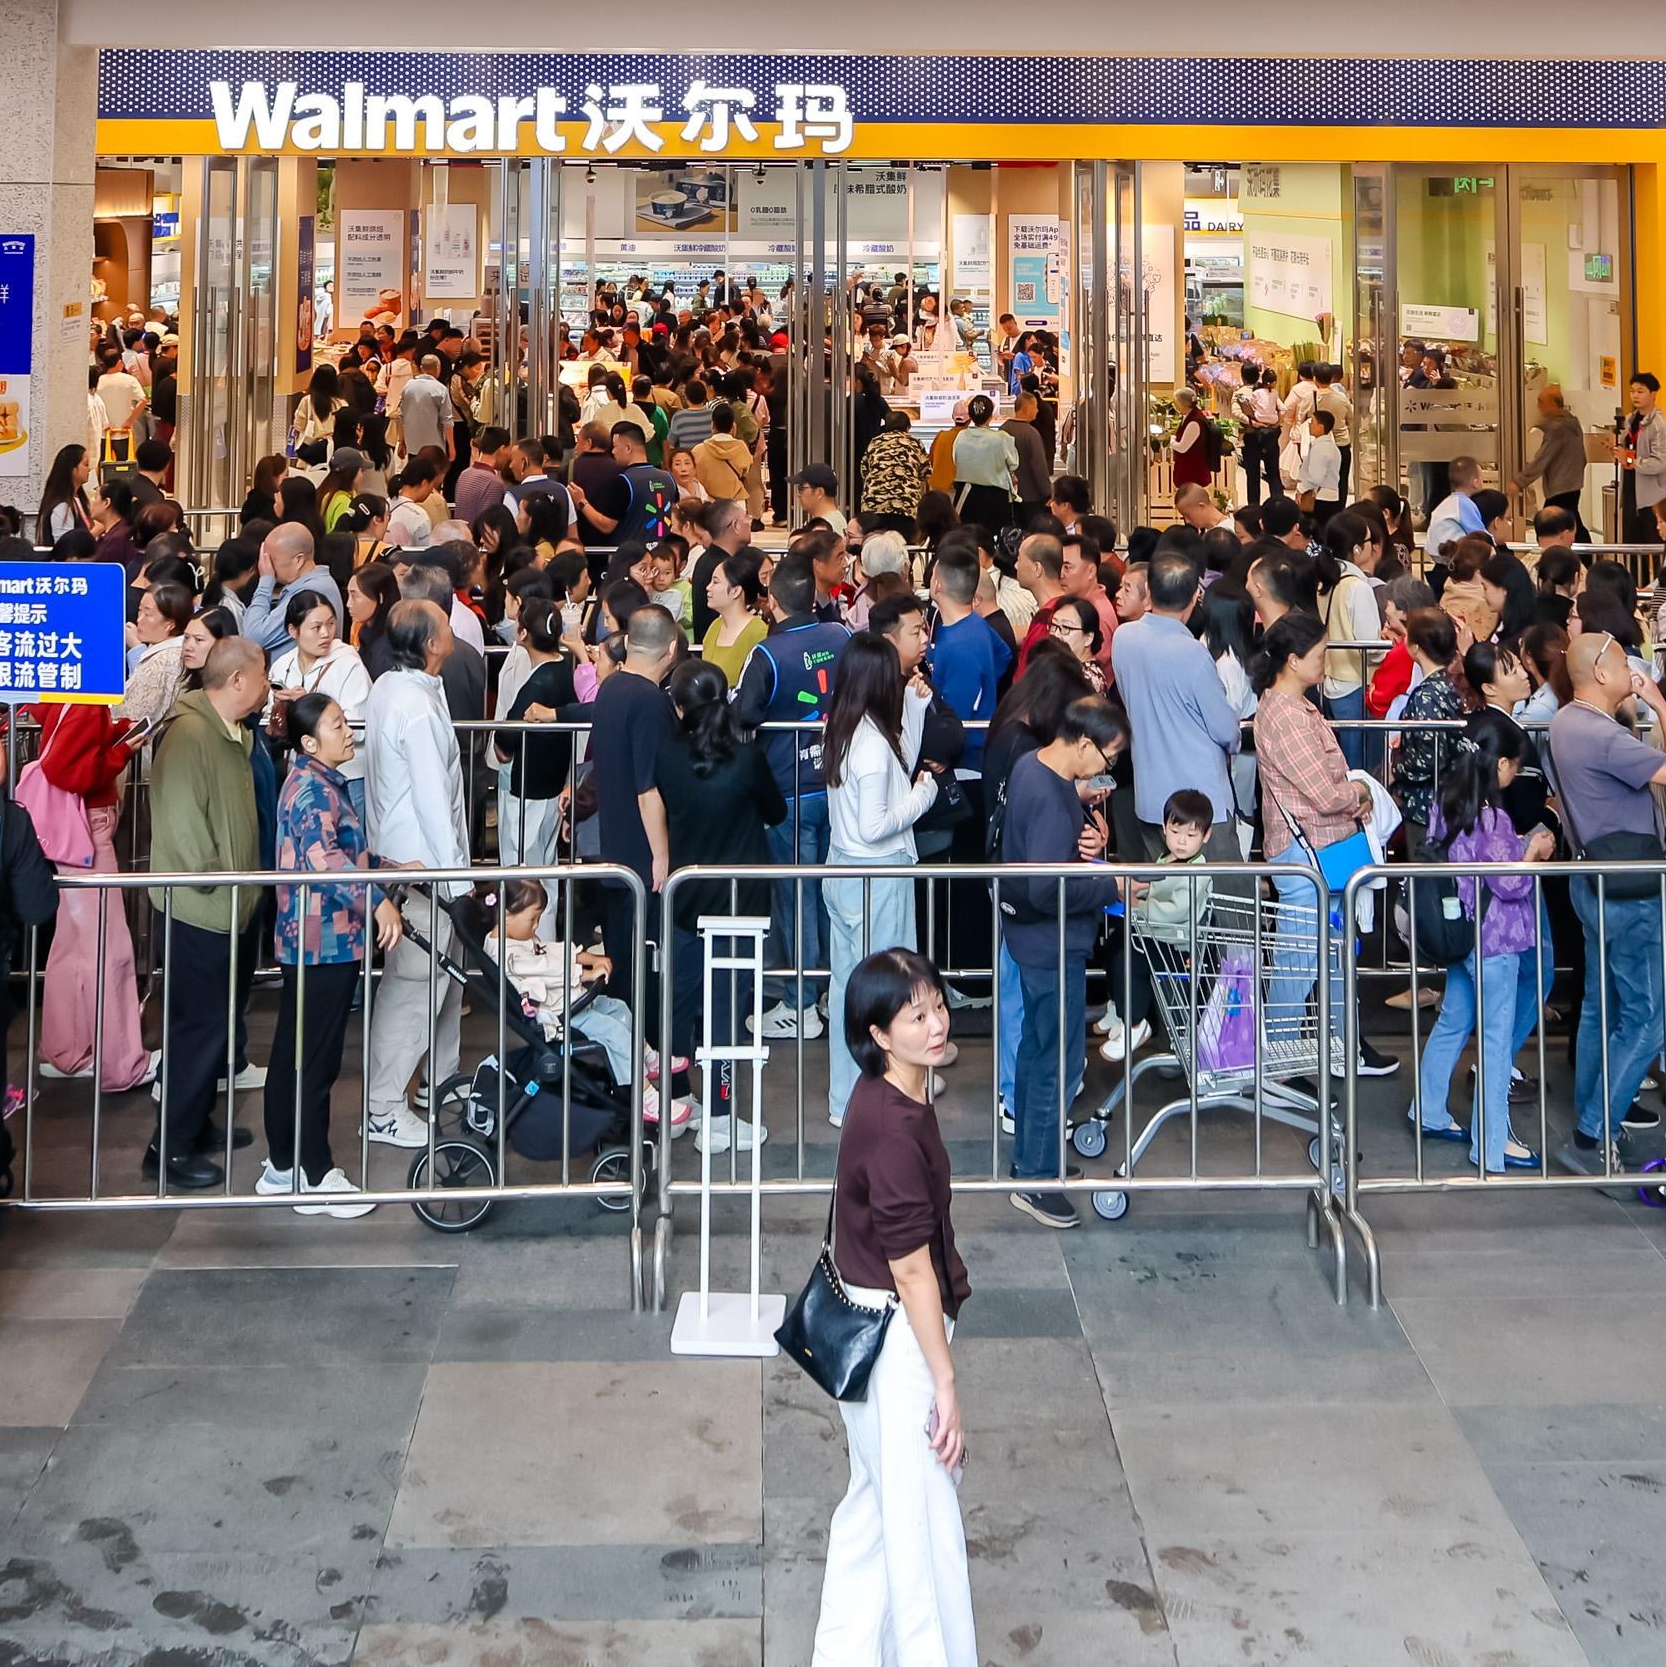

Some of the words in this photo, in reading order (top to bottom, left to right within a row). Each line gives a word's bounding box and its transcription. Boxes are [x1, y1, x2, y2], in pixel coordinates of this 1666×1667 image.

[209, 80, 566, 152] Walmart
[579, 79, 857, 154] 沃尔玛
[1207, 222, 1244, 231] DAIRY
[35, 576, 88, 596] 沃尔玛
